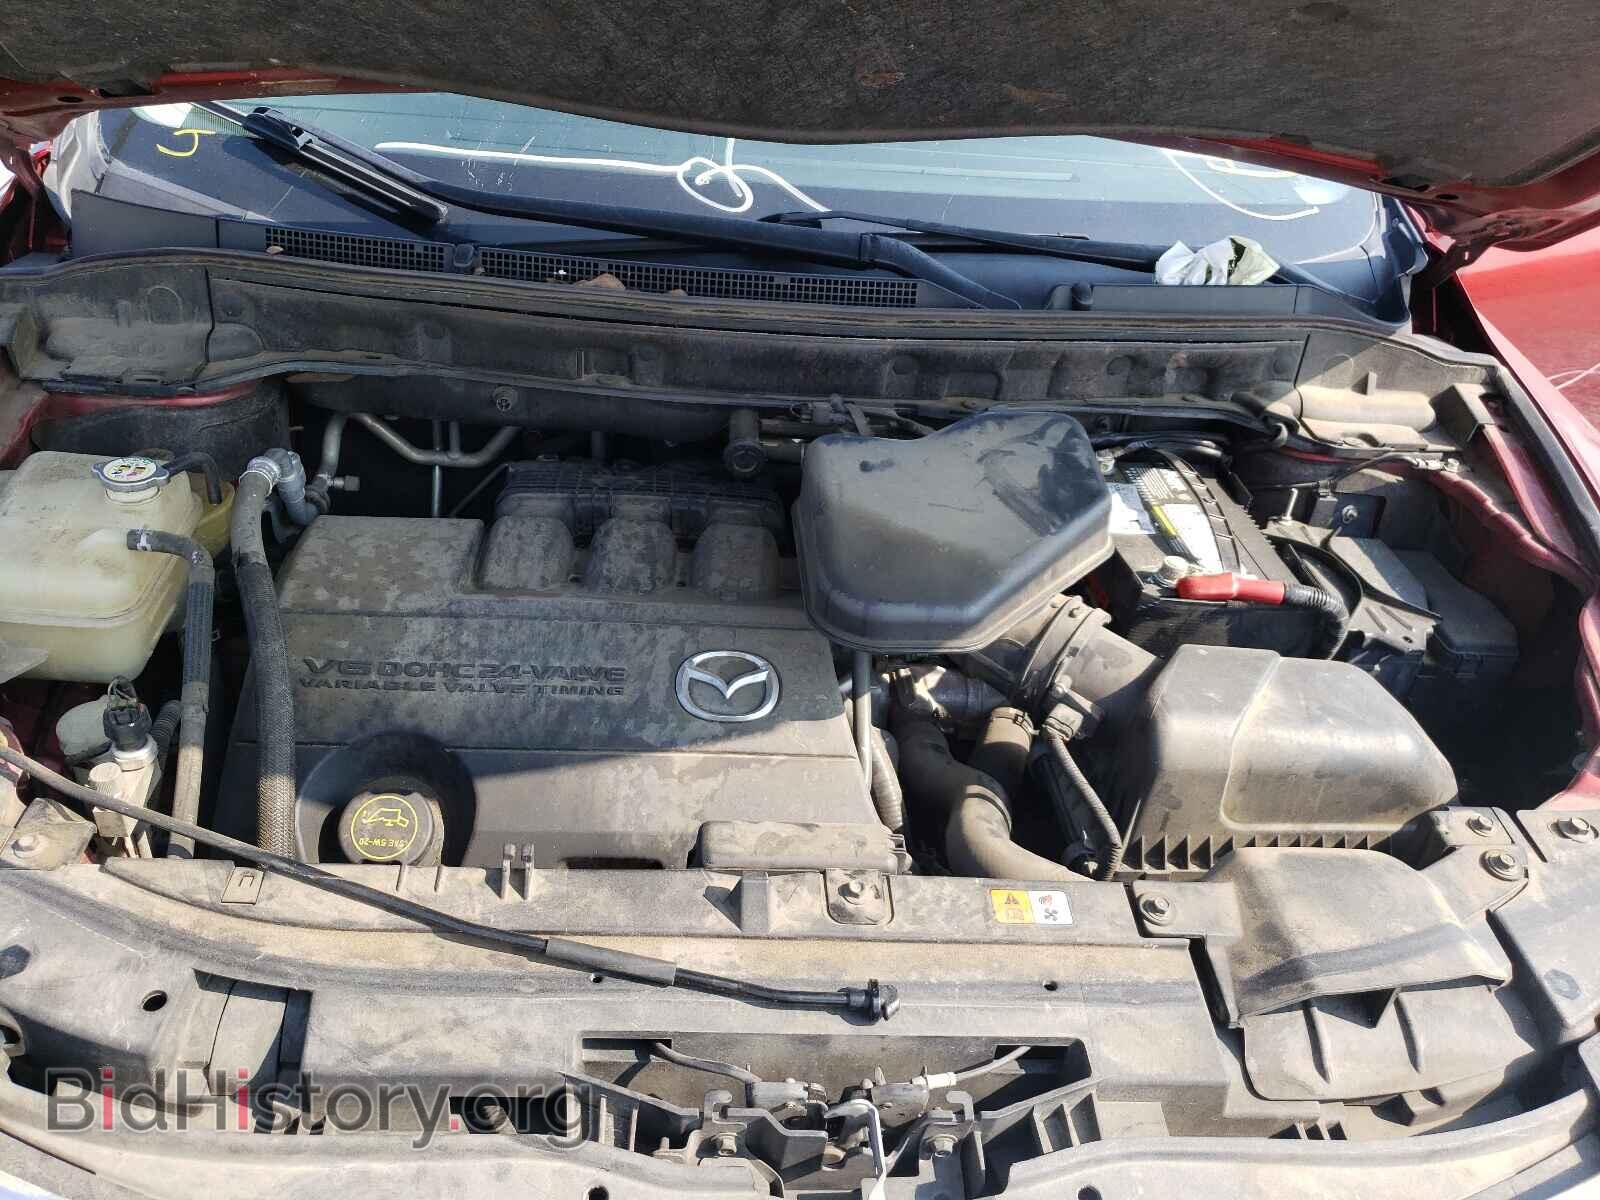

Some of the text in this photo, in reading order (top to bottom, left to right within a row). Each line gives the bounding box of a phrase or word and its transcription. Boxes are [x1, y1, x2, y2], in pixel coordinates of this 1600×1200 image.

[303, 656, 625, 682] V6 DOHC 24-VALVE
[301, 678, 625, 696] VARIABLE VALVE TIMING
[358, 837, 387, 847] 5W-20
